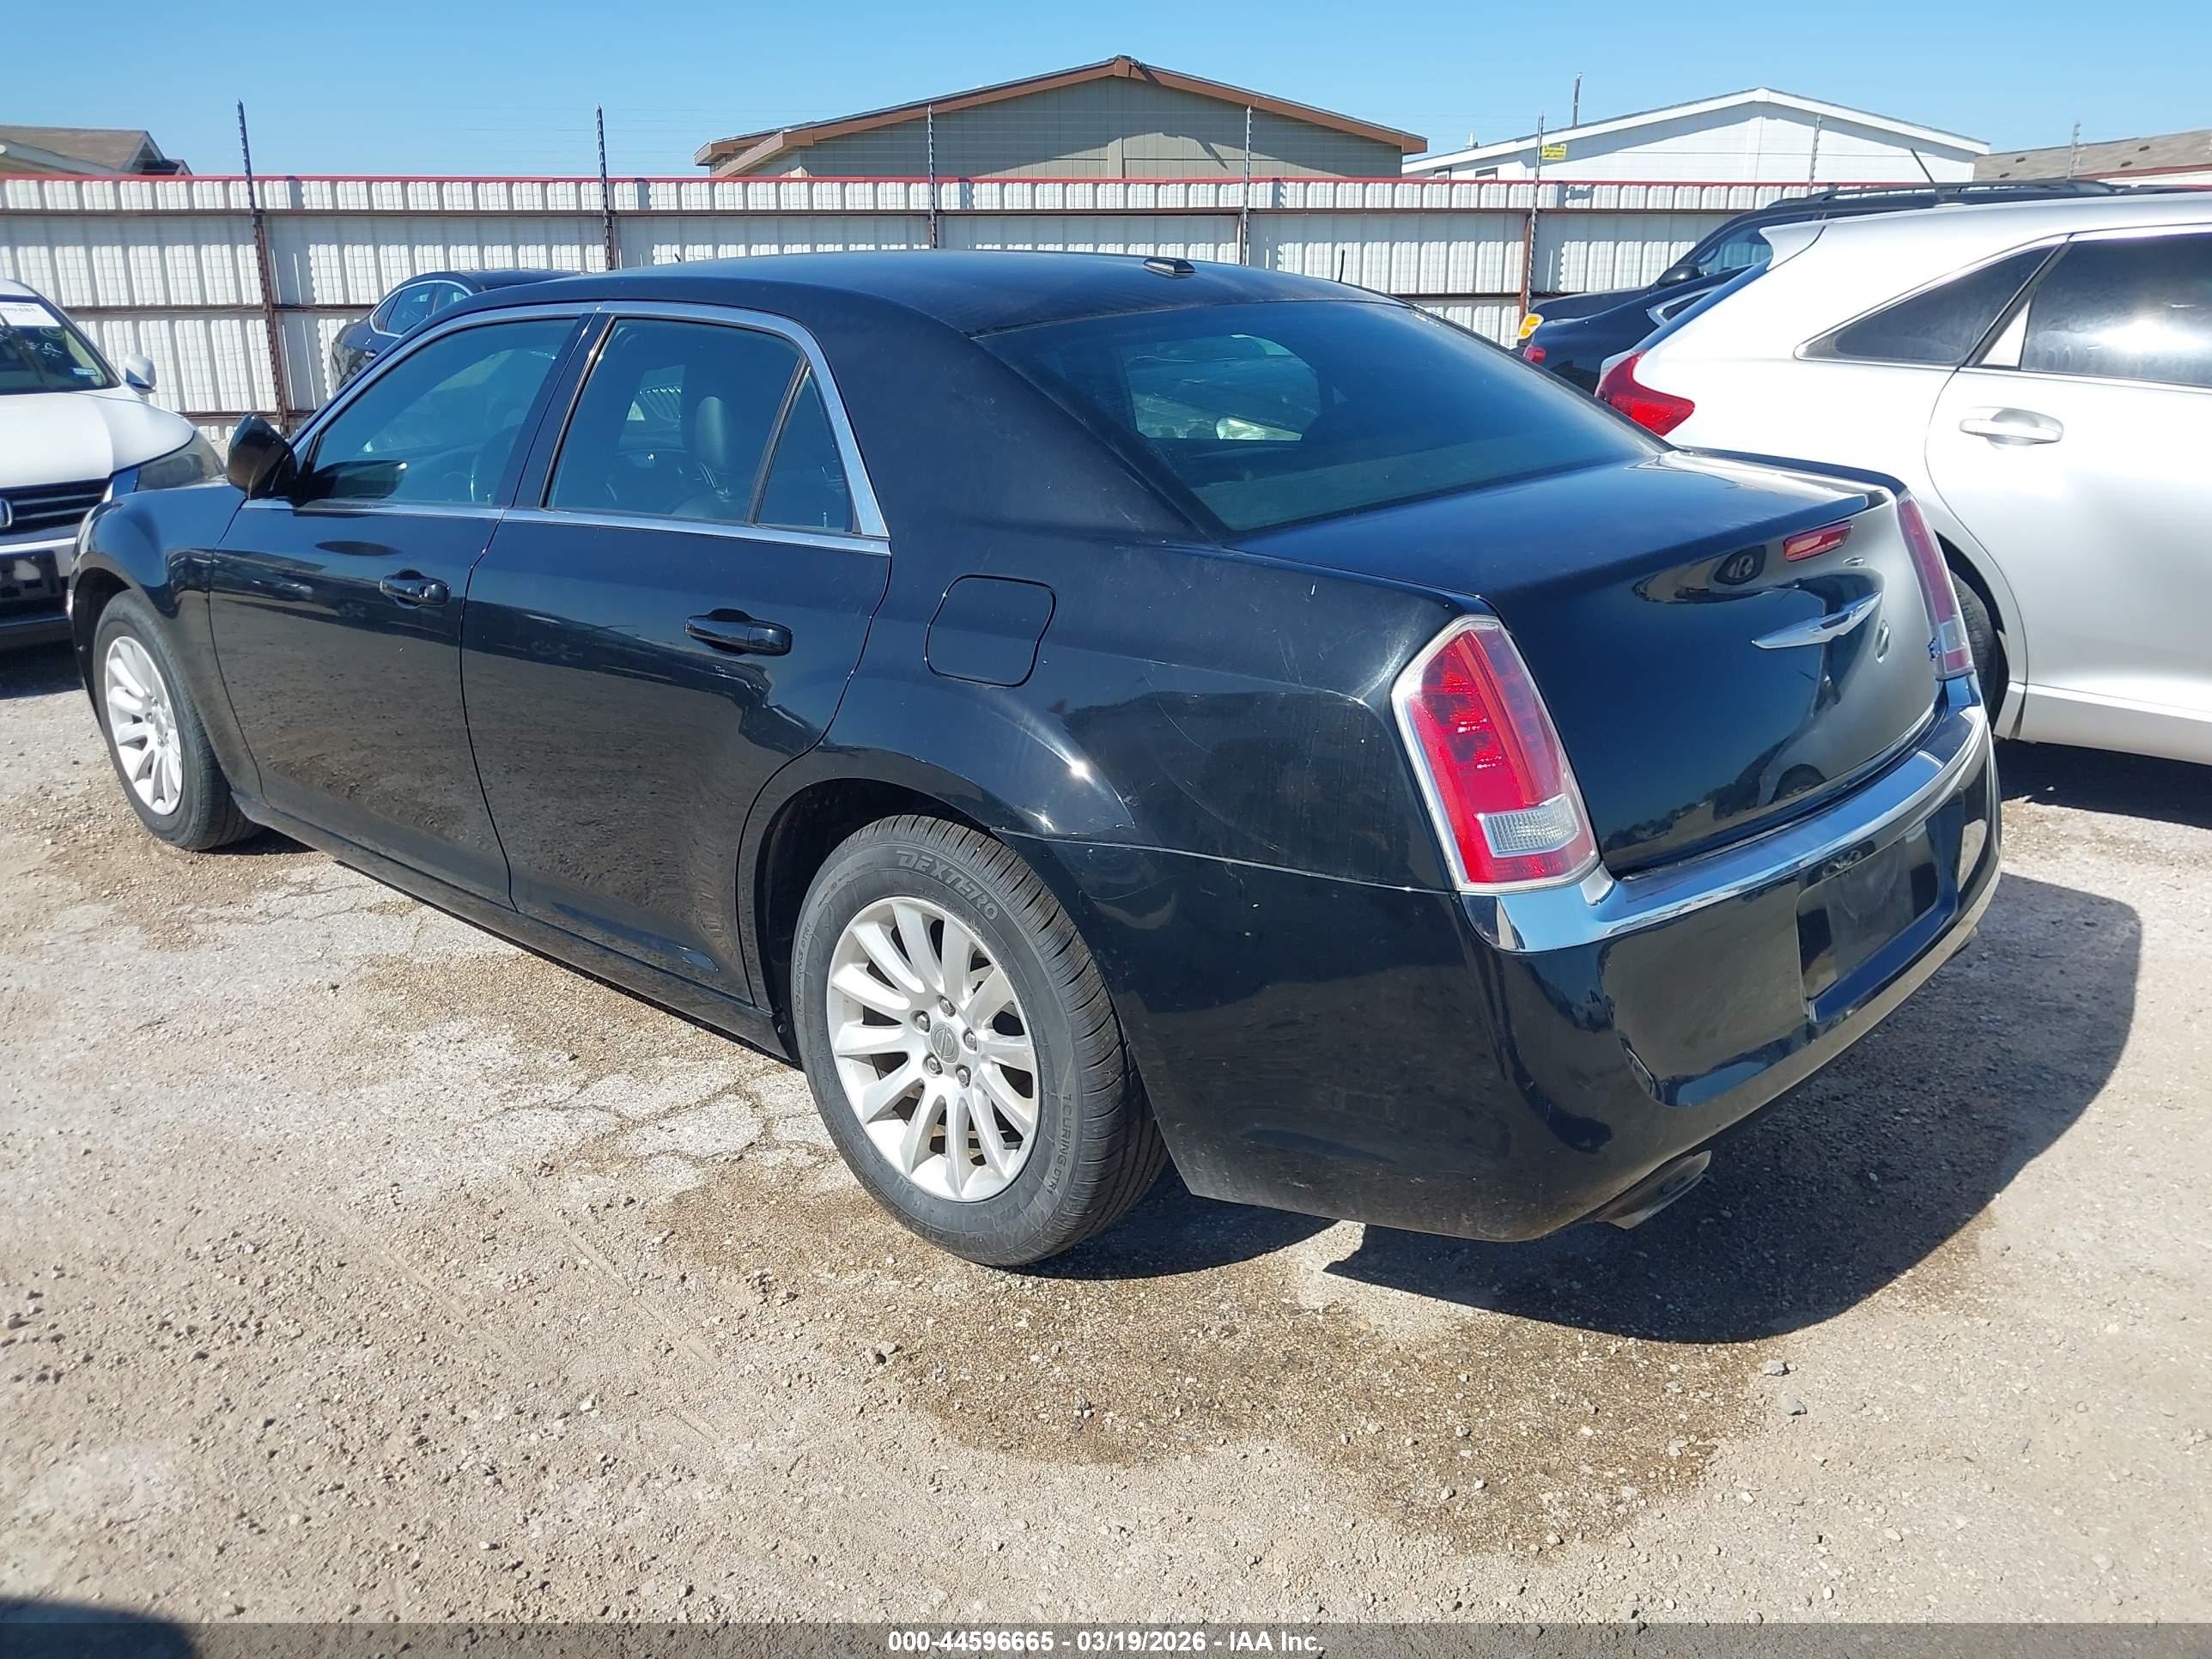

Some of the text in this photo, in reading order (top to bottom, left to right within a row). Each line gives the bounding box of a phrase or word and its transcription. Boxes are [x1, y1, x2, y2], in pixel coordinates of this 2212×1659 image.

[896, 850, 998, 921] DEXTERO
[1046, 1093, 1073, 1195] TOURING DTR1
